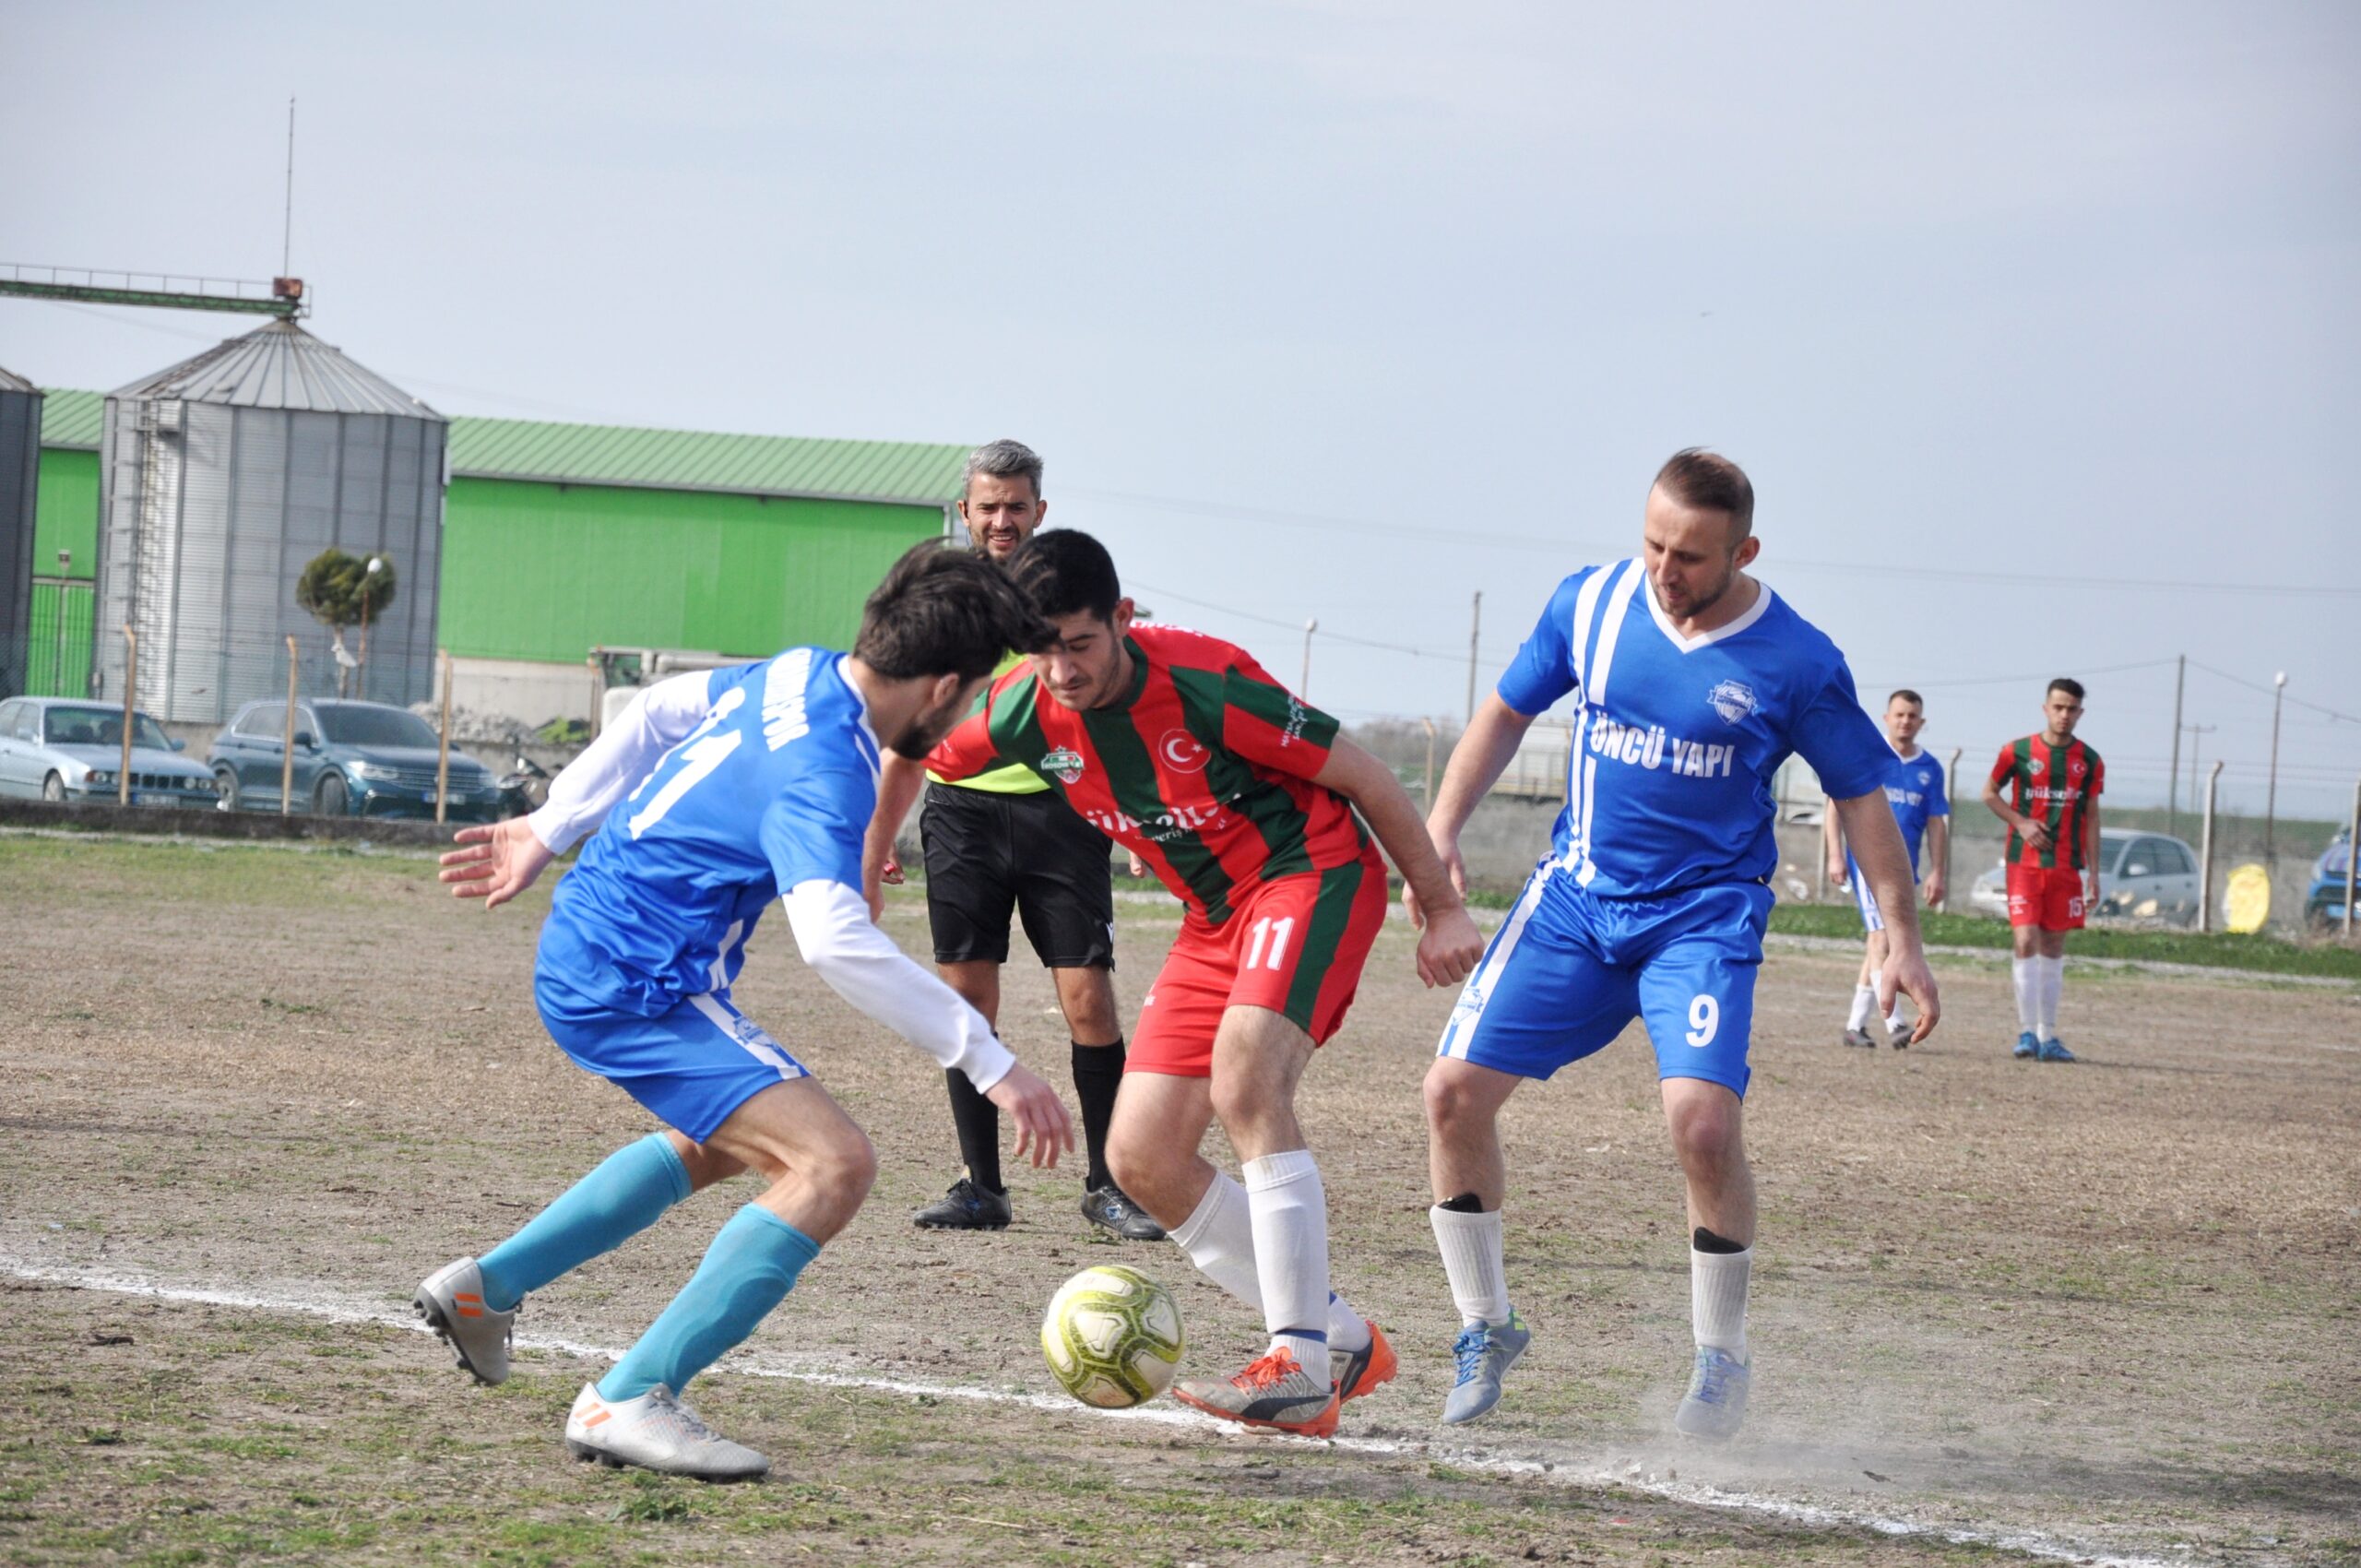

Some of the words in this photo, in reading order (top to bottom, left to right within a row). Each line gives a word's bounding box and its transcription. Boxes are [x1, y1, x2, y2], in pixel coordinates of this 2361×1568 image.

[1589, 709, 1667, 770] ÖNCÜ
[1672, 737, 1735, 778] YAPI
[1246, 916, 1295, 971] 11
[1685, 993, 1720, 1048] 9
